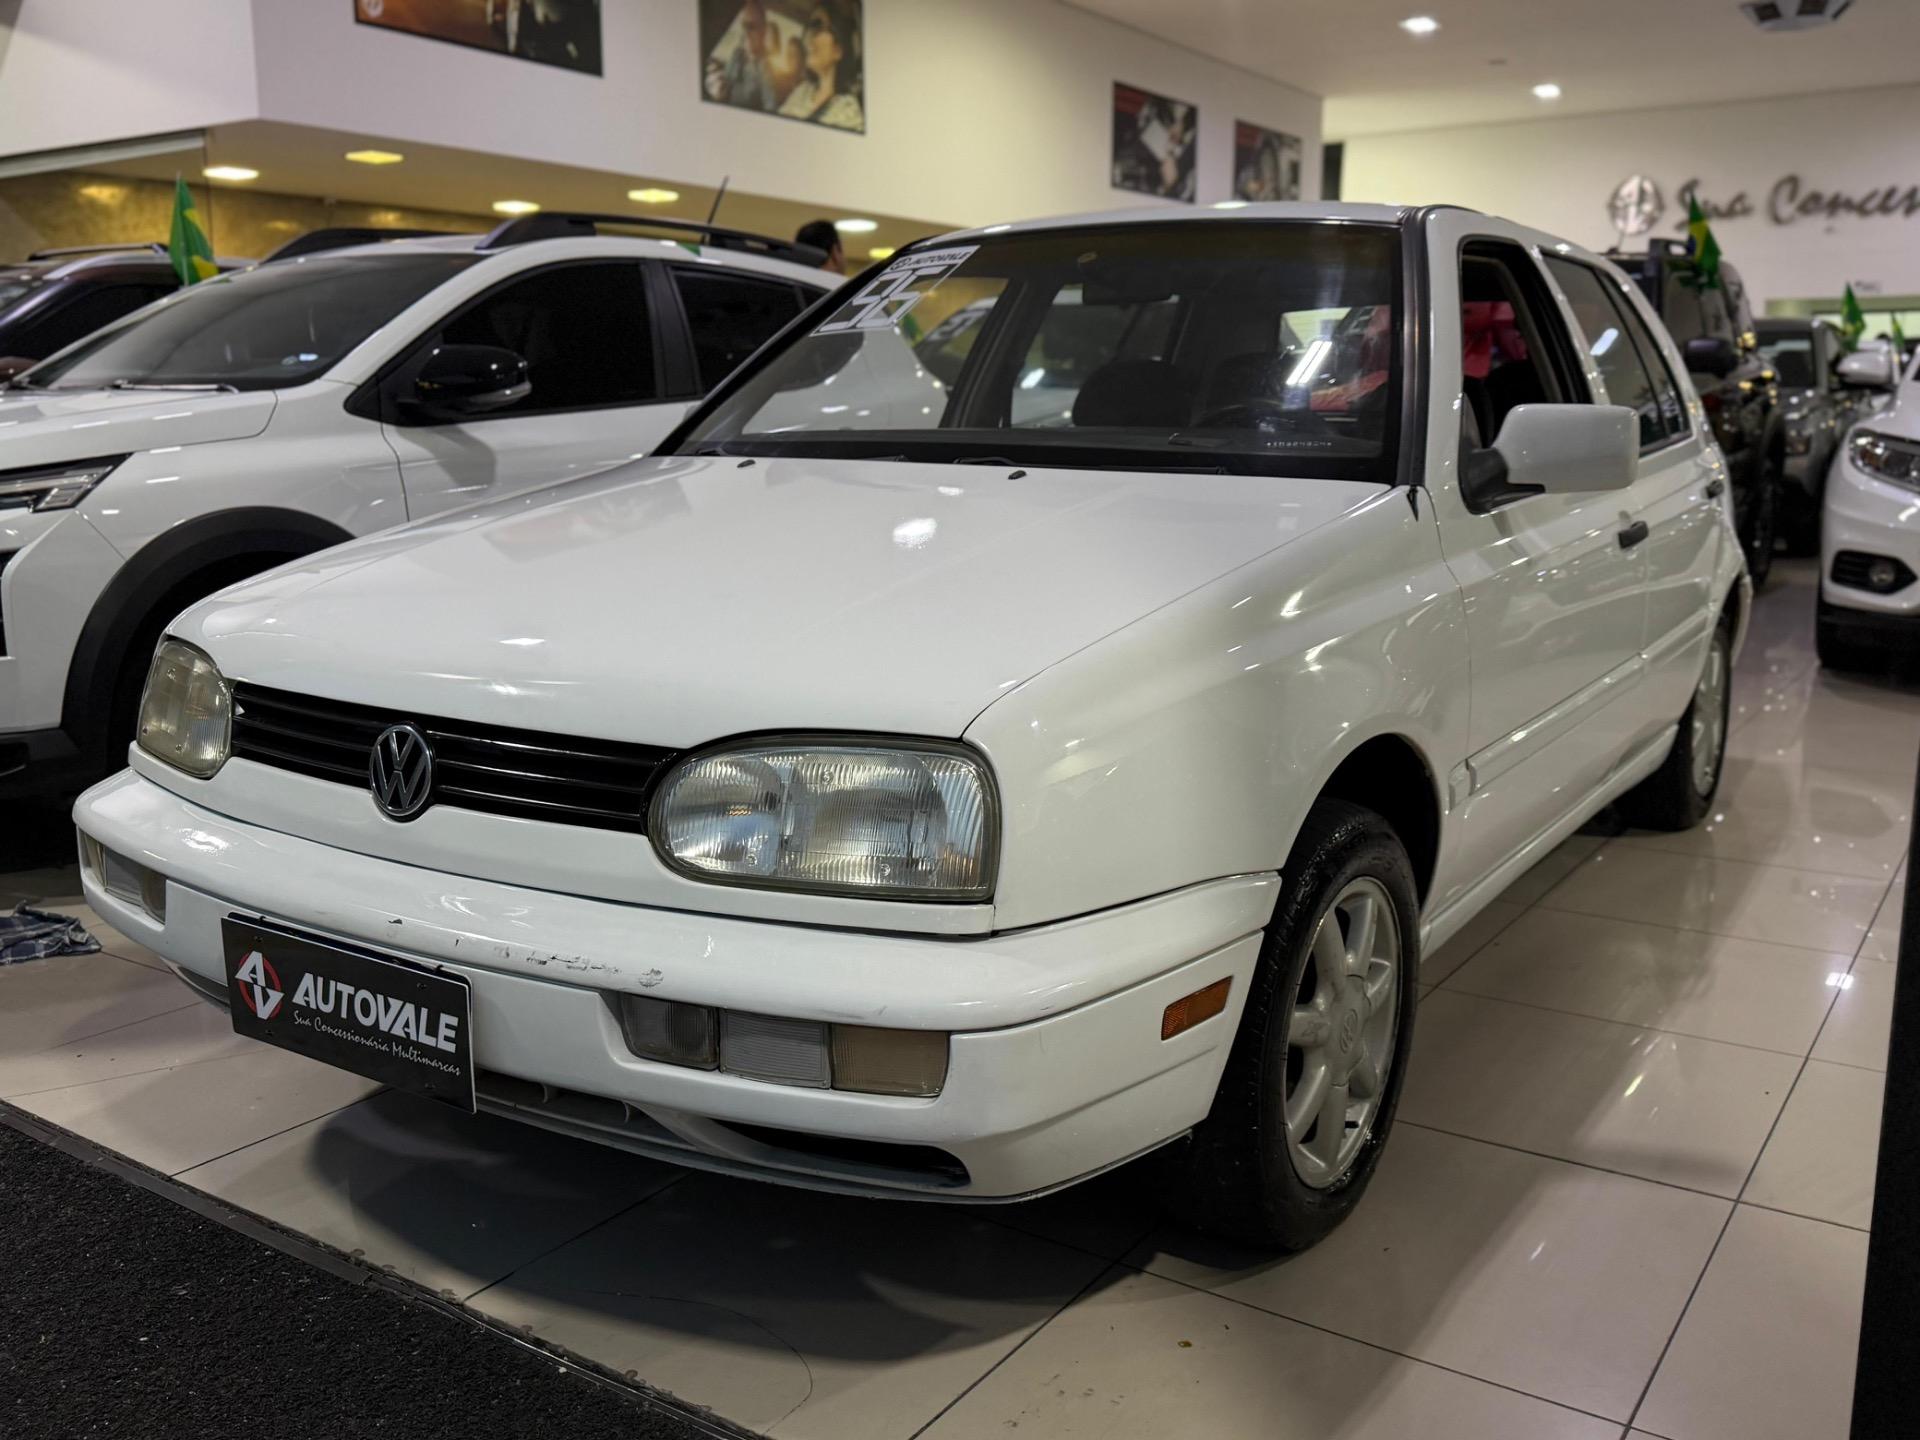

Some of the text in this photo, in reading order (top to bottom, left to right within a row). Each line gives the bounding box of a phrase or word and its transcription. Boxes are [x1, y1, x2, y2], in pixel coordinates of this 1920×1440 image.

[292, 972, 459, 1053] AUTOVALE
[293, 1009, 461, 1077] Sua Concessionária Multimarcas
